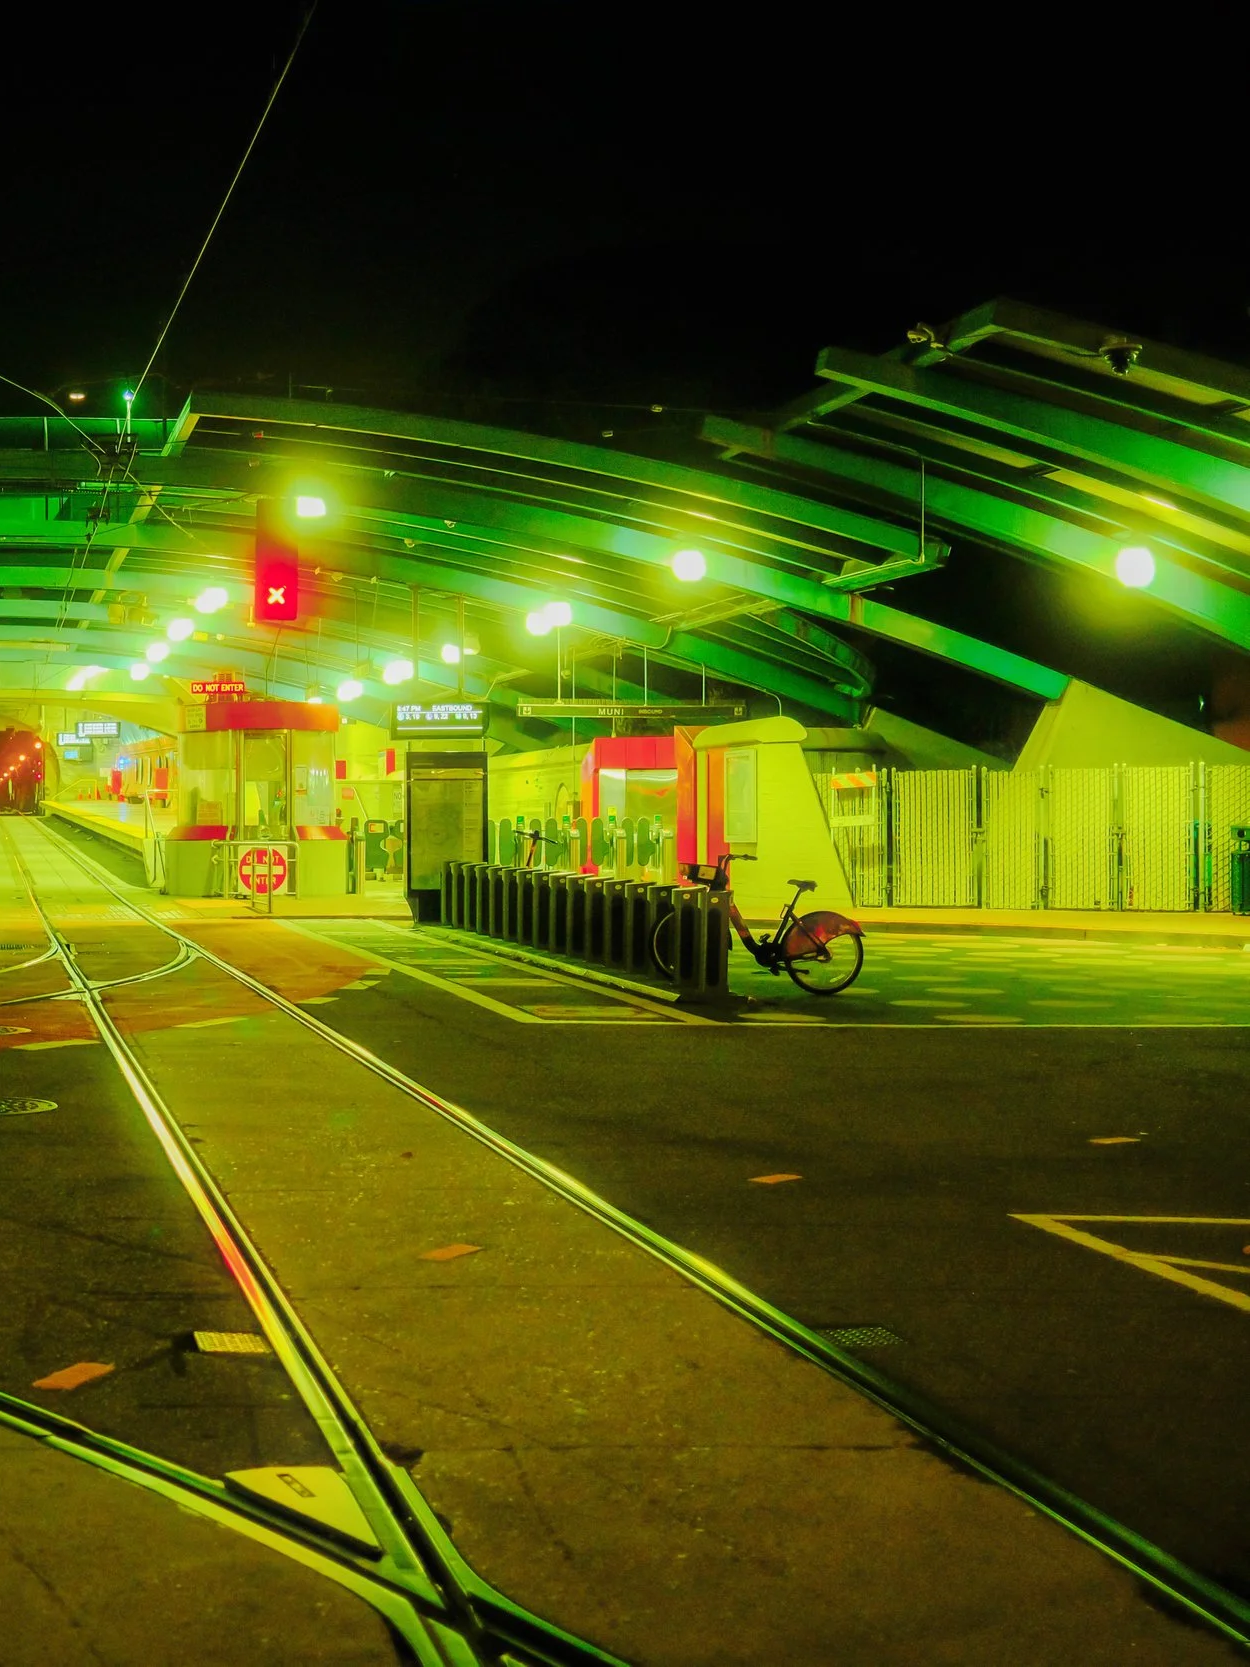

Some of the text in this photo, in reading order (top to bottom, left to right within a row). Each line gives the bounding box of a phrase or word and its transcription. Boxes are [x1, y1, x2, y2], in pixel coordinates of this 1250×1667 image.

[193, 684, 243, 692] DO NOT ENTER
